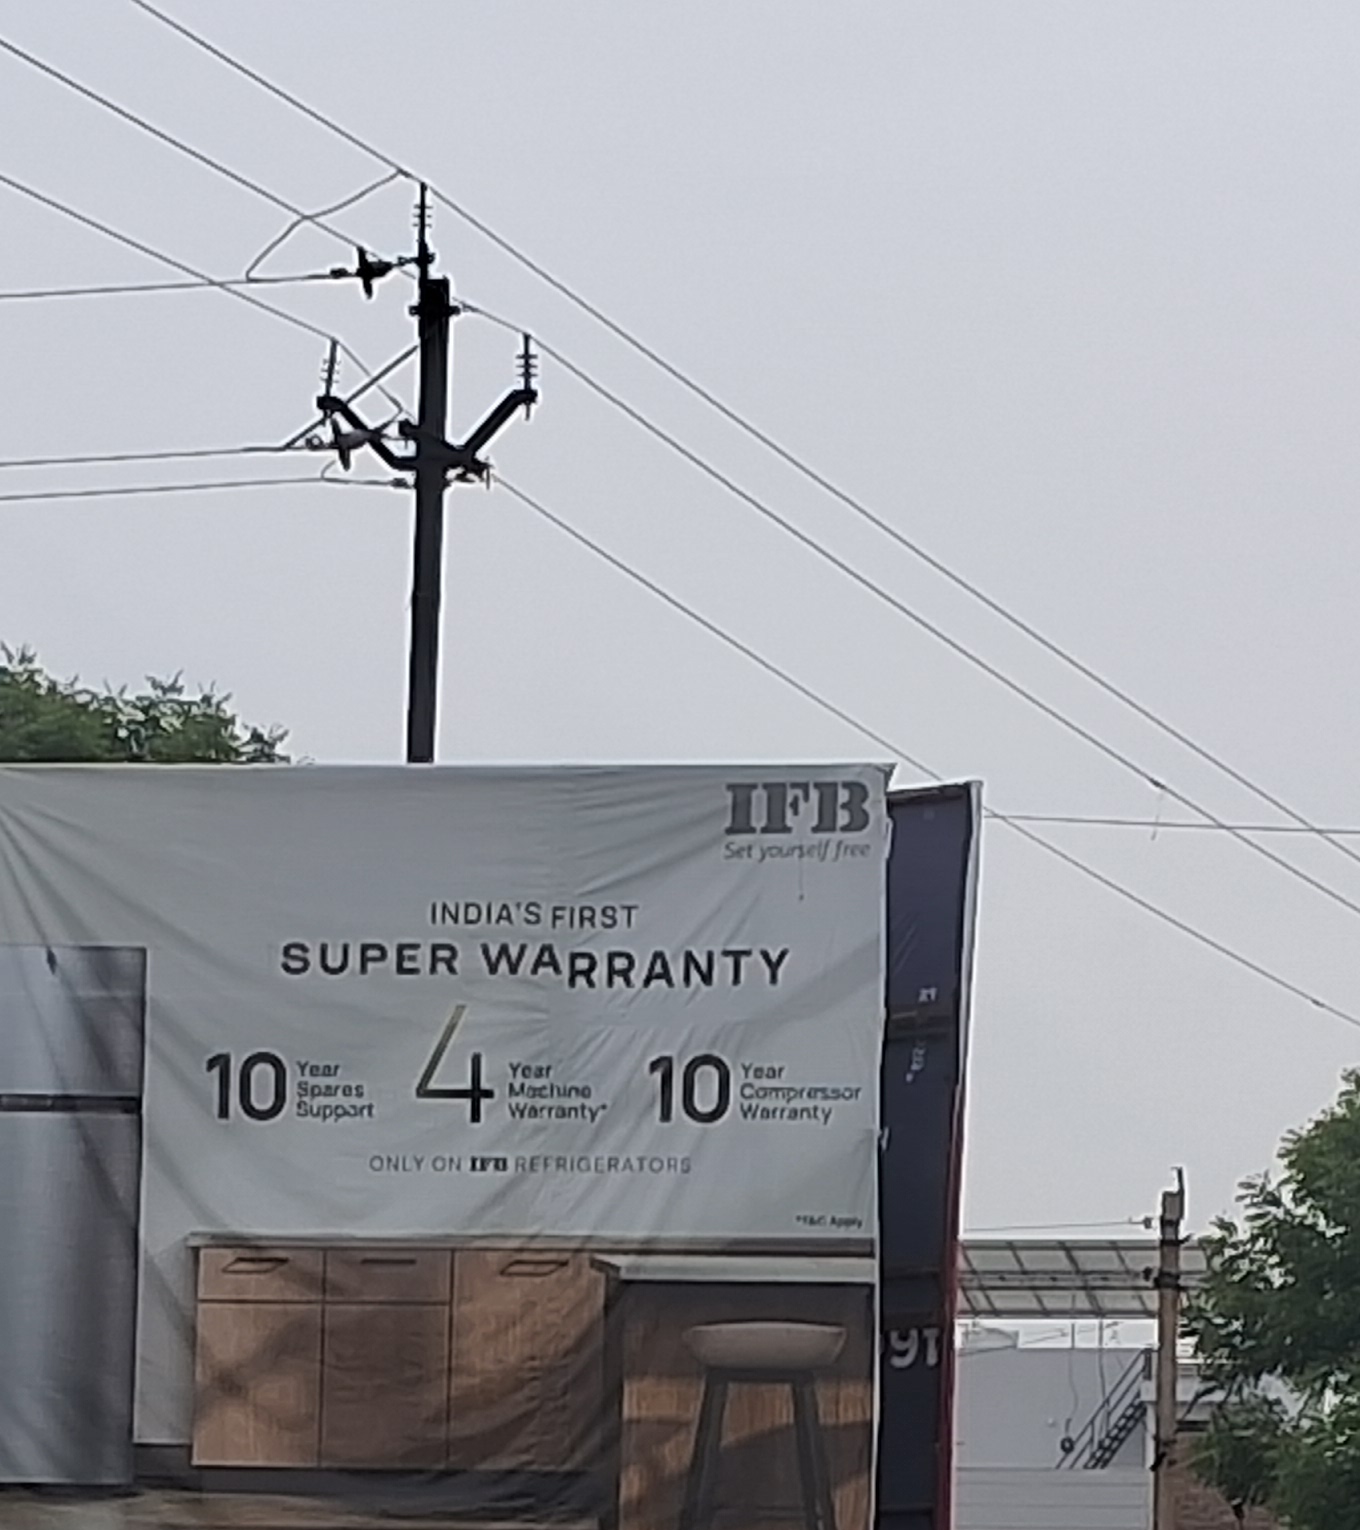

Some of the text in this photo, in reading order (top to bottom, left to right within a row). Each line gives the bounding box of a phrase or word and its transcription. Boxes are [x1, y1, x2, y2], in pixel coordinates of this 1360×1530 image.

[724, 781, 870, 834] IFB
[723, 839, 871, 863] Set yourself free
[430, 901, 639, 929] INDIA'S FIRST
[280, 942, 790, 989] SUPER WARRANTY
[296, 1059, 341, 1077] Year
[415, 1003, 496, 1124] 4
[508, 1061, 553, 1079] Year
[740, 1062, 786, 1080] Year
[205, 1050, 287, 1122] 10
[296, 1080, 365, 1101] Spares
[508, 1081, 593, 1100] Machine
[648, 1053, 732, 1124] 10
[739, 1083, 862, 1105] Compressor
[296, 1101, 376, 1123] Support
[739, 1104, 833, 1126] Warranty
[368, 1155, 692, 1175] ONLY ON IFB REFRIGERATORS
